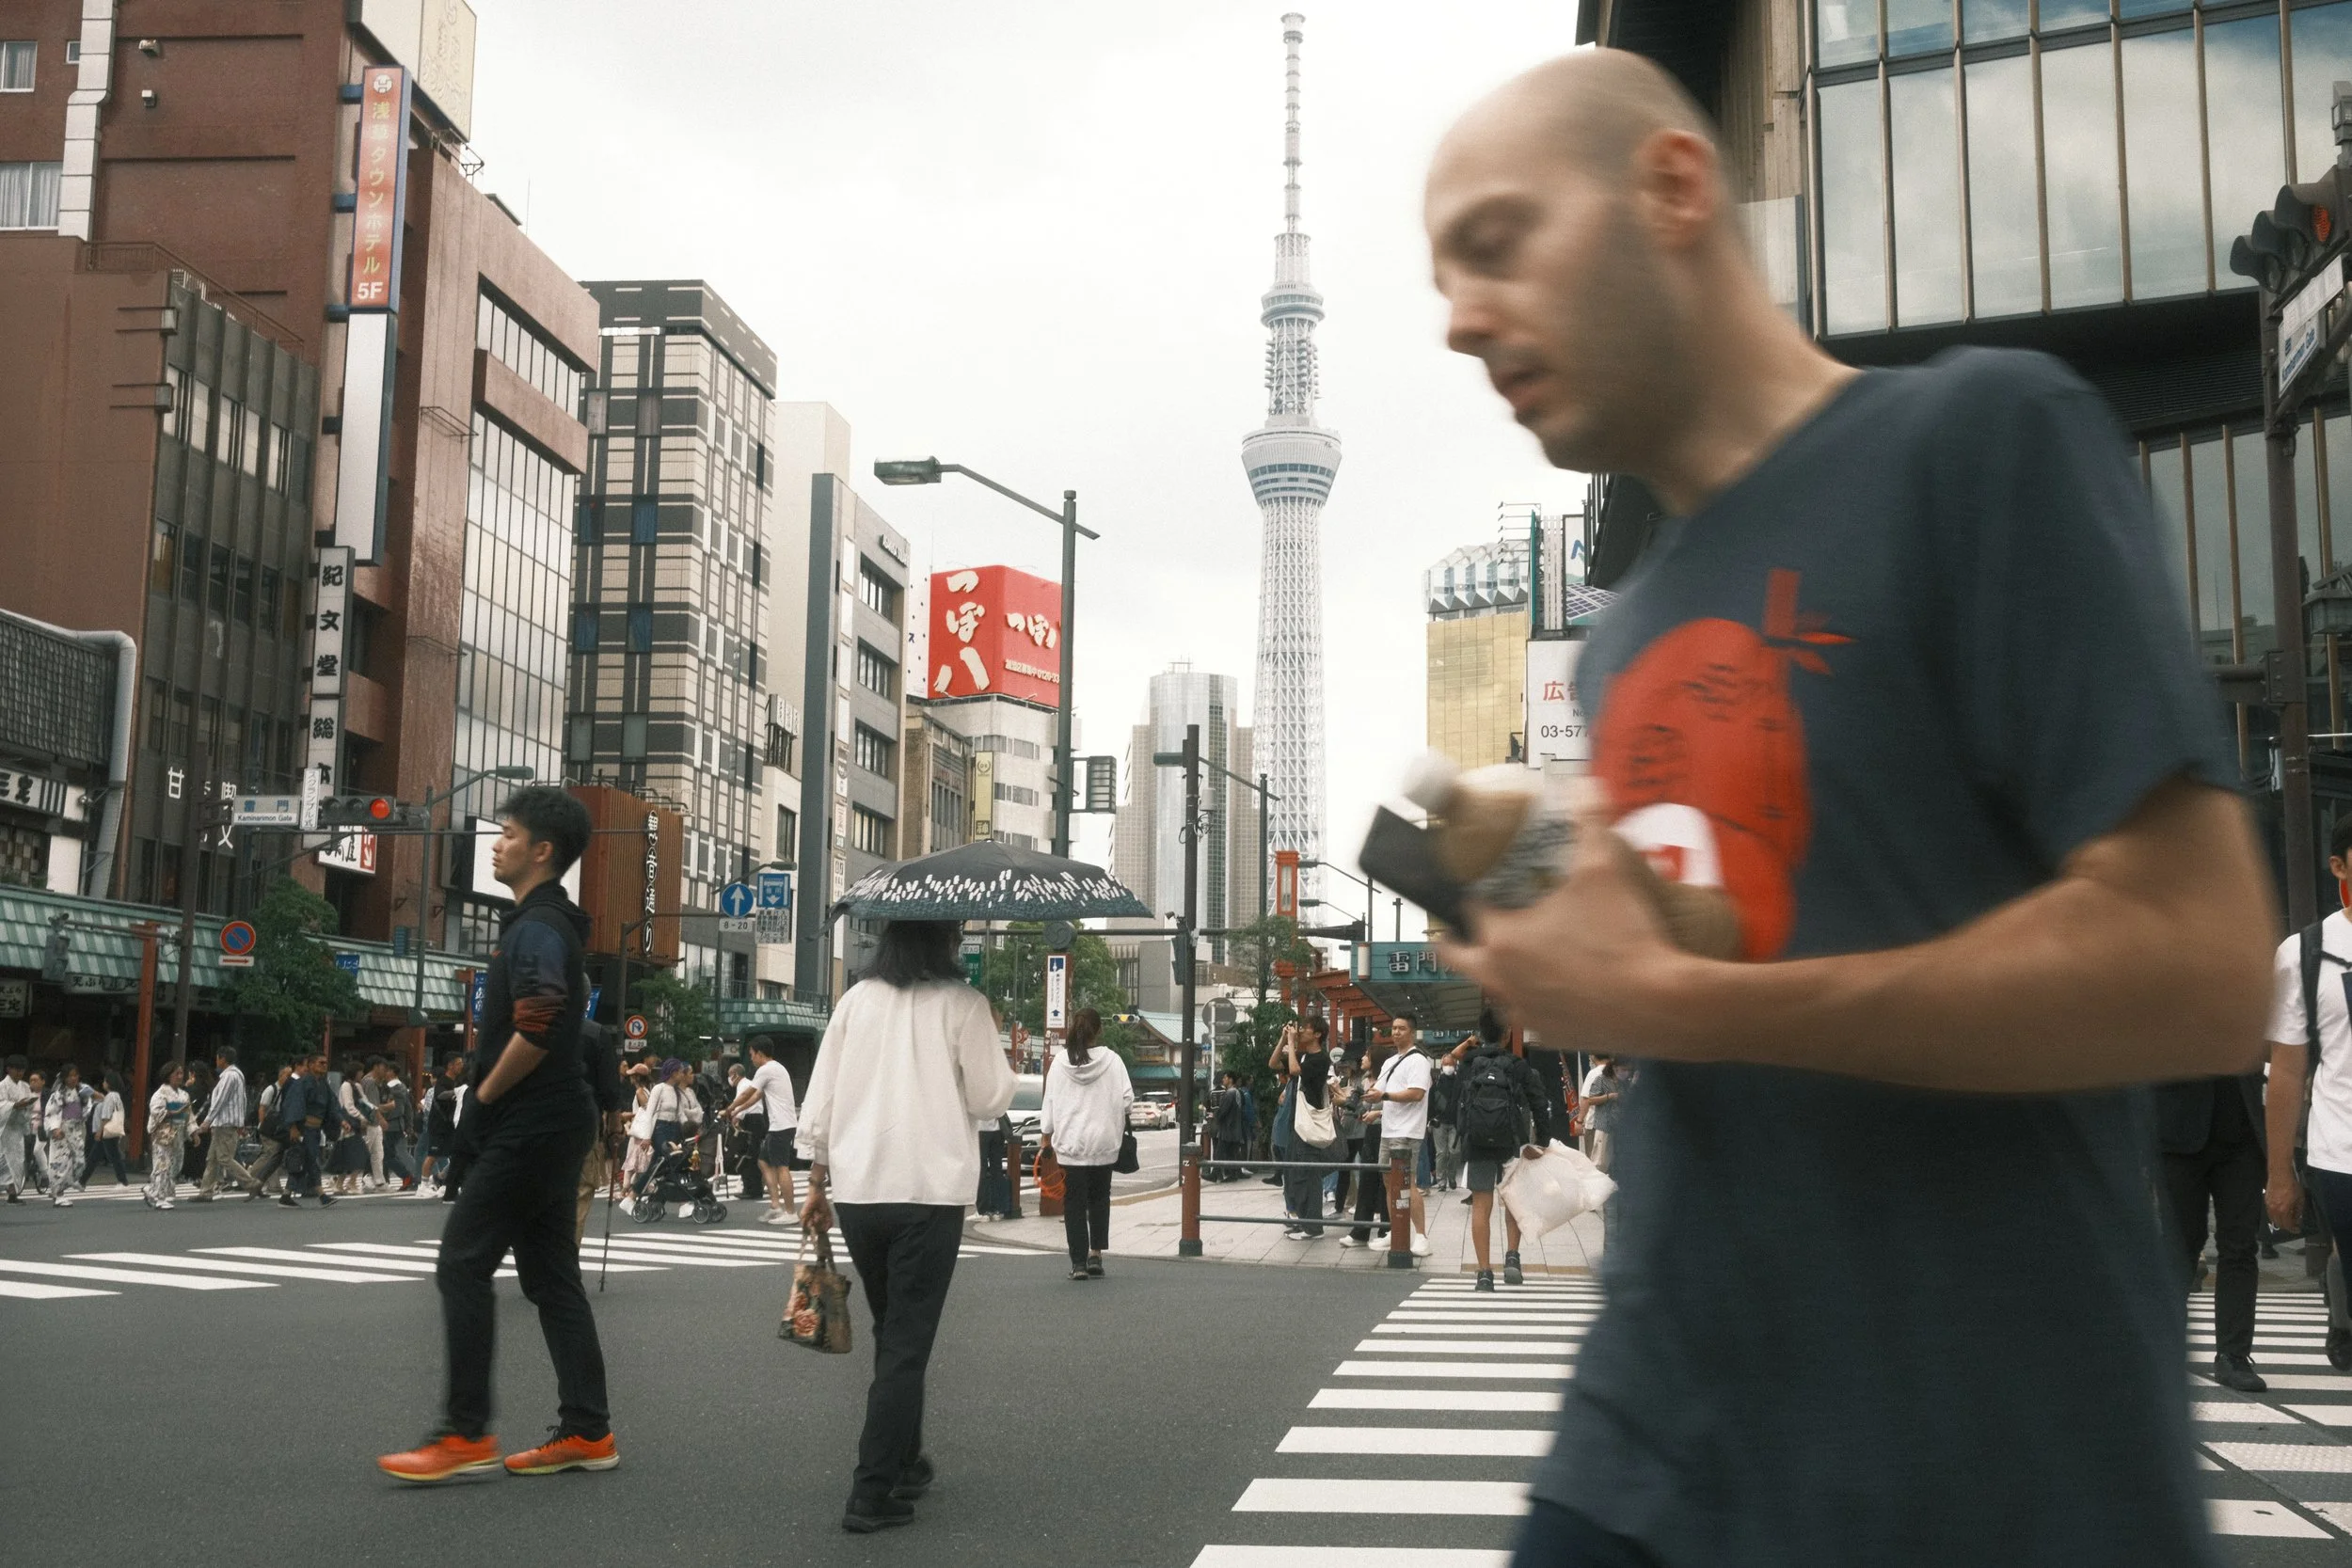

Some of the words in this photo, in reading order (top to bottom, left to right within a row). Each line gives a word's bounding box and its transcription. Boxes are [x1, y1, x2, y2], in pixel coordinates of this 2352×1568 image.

[358, 281, 384, 300] 5F
[933, 570, 991, 691] つぼ八
[312, 564, 344, 785] 紀文堂総
[244, 799, 290, 813] 雷門
[1389, 950, 1454, 974] 雷門
